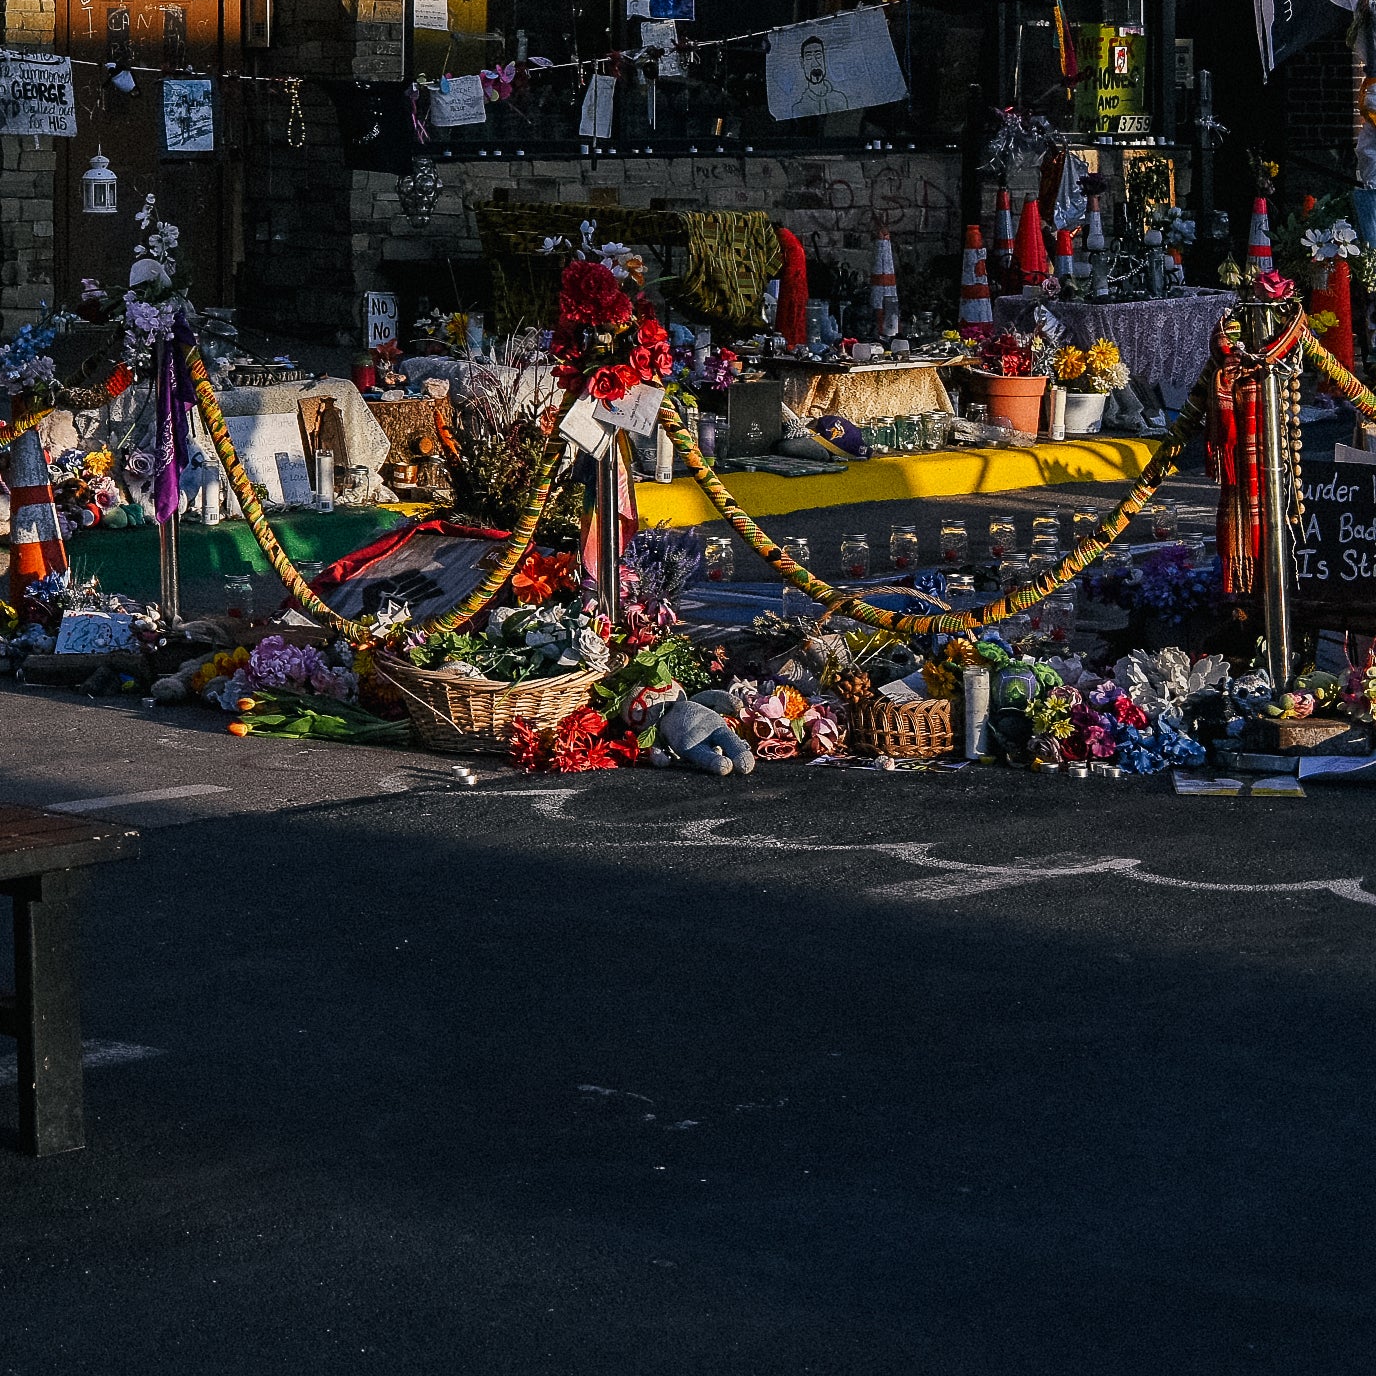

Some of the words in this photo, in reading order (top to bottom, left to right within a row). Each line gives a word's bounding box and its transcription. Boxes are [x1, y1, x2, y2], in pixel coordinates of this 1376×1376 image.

[11, 80, 68, 106] GEORGE
[1097, 95, 1120, 112] AND
[47, 115, 67, 132] HIS
[1118, 116, 1151, 132] 3759
[1302, 471, 1360, 503] urder
[1305, 513, 1322, 542] A
[1296, 548, 1329, 580] Is
